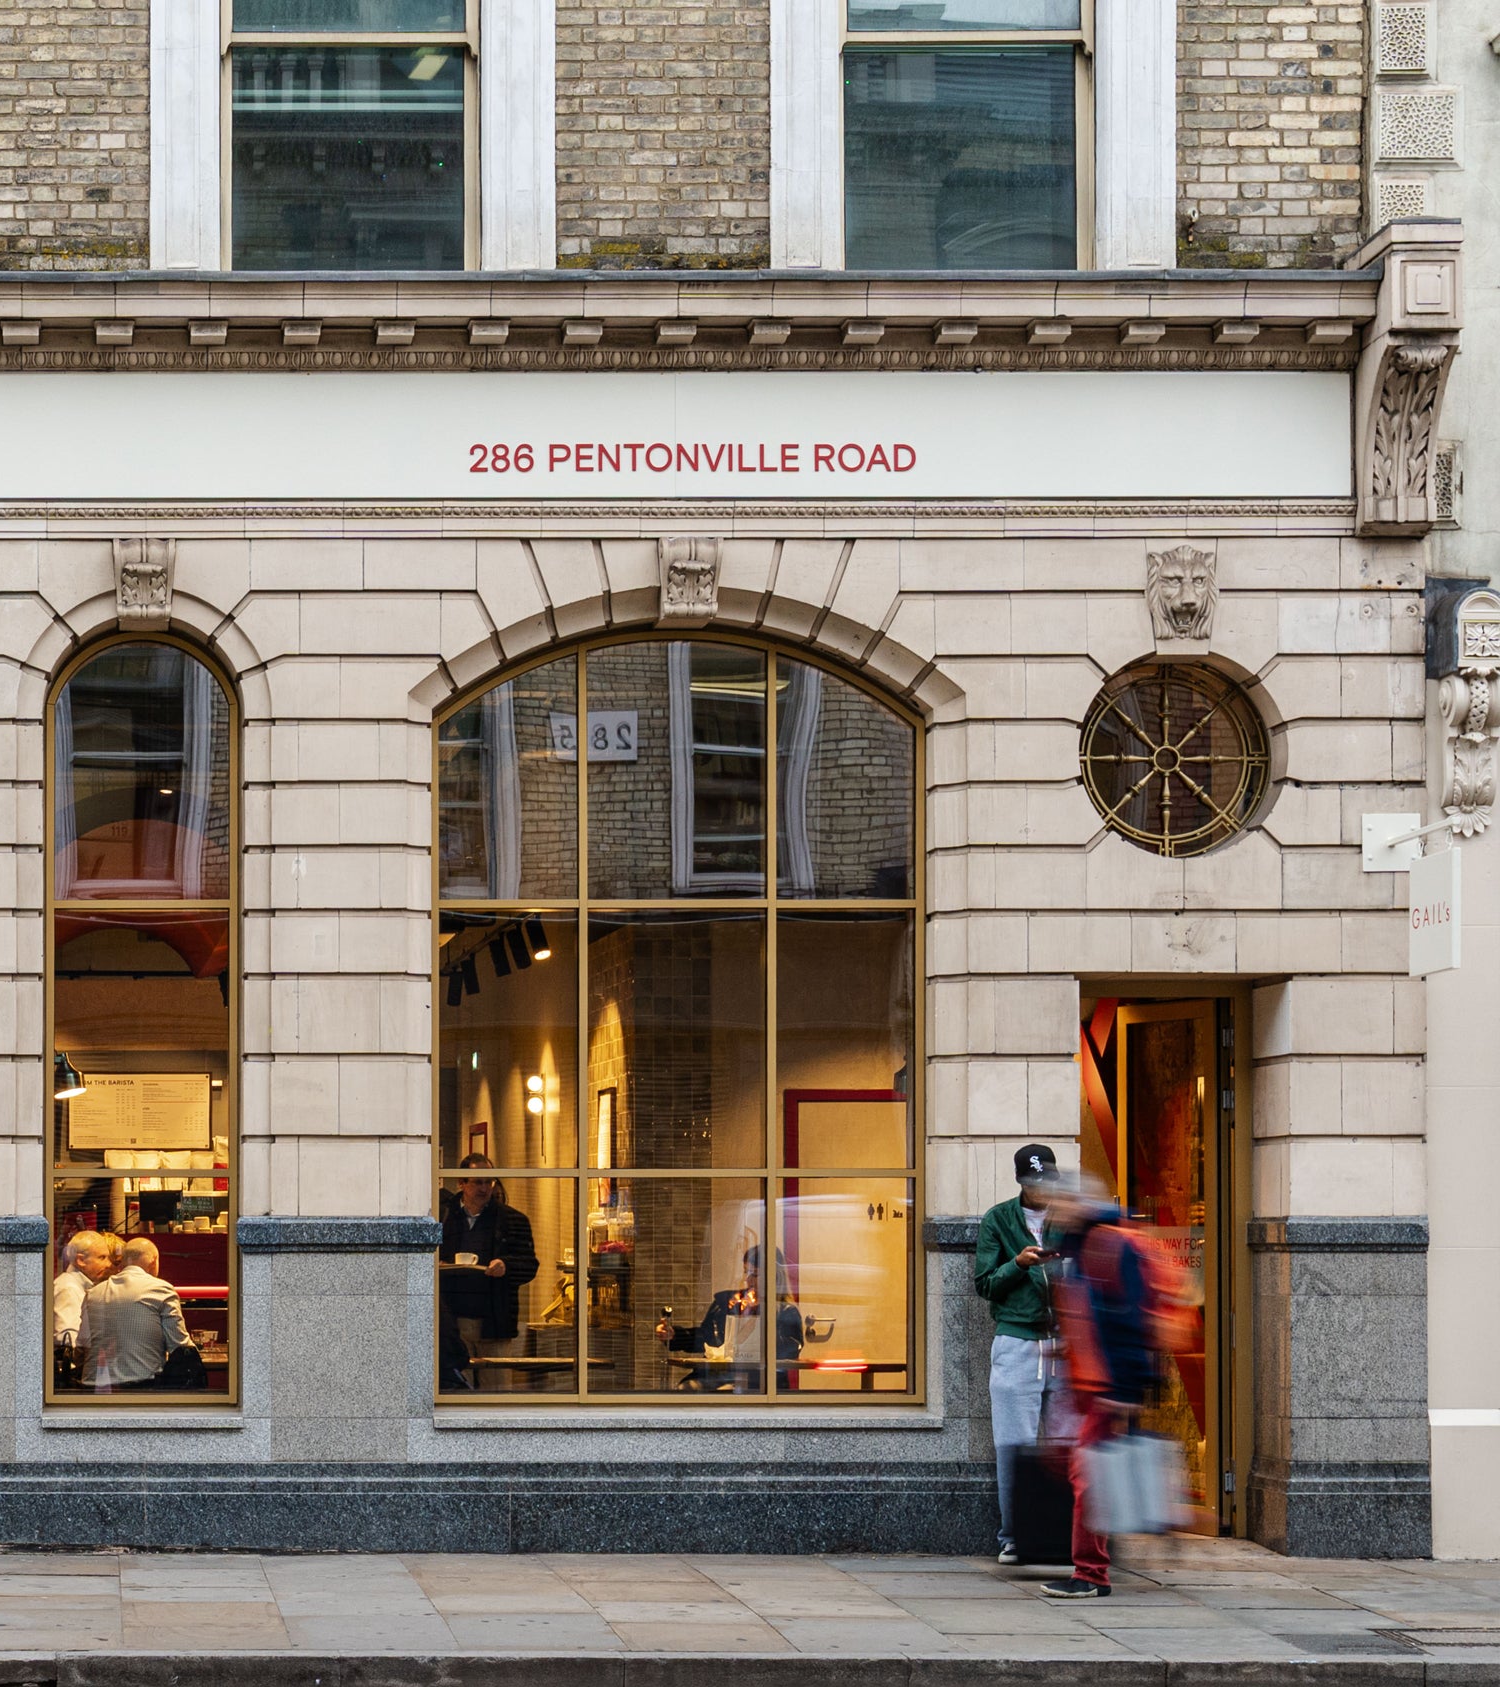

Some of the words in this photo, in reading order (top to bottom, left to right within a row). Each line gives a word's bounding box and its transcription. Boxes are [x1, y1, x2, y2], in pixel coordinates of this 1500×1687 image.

[469, 443, 534, 473] 286
[549, 443, 800, 473] PENTONVILLE
[814, 443, 917, 473] ROAD
[1411, 900, 1451, 930] GAIL's
[1162, 1238, 1182, 1250] WAY
[1184, 1238, 1204, 1250] FOR
